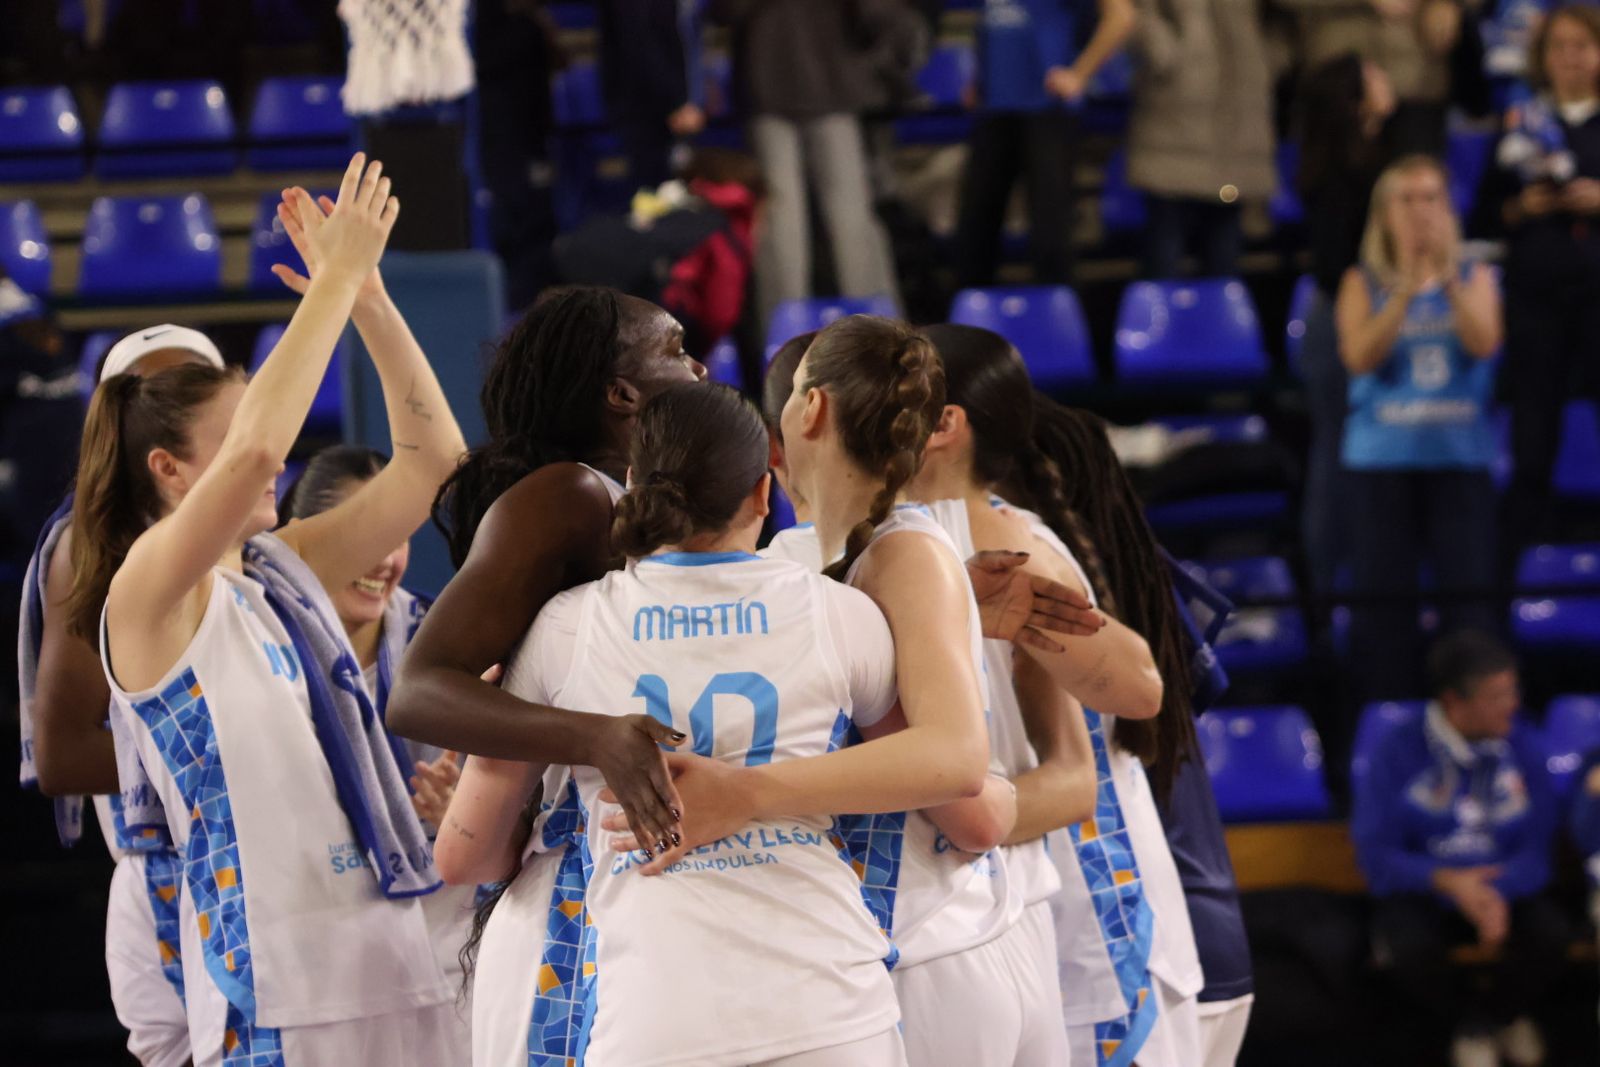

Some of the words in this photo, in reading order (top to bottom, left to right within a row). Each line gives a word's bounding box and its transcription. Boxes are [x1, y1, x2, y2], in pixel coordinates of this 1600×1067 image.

[633, 596, 769, 641] MARTÍN
[632, 671, 779, 767] 10
[758, 826, 821, 848] LEÓN
